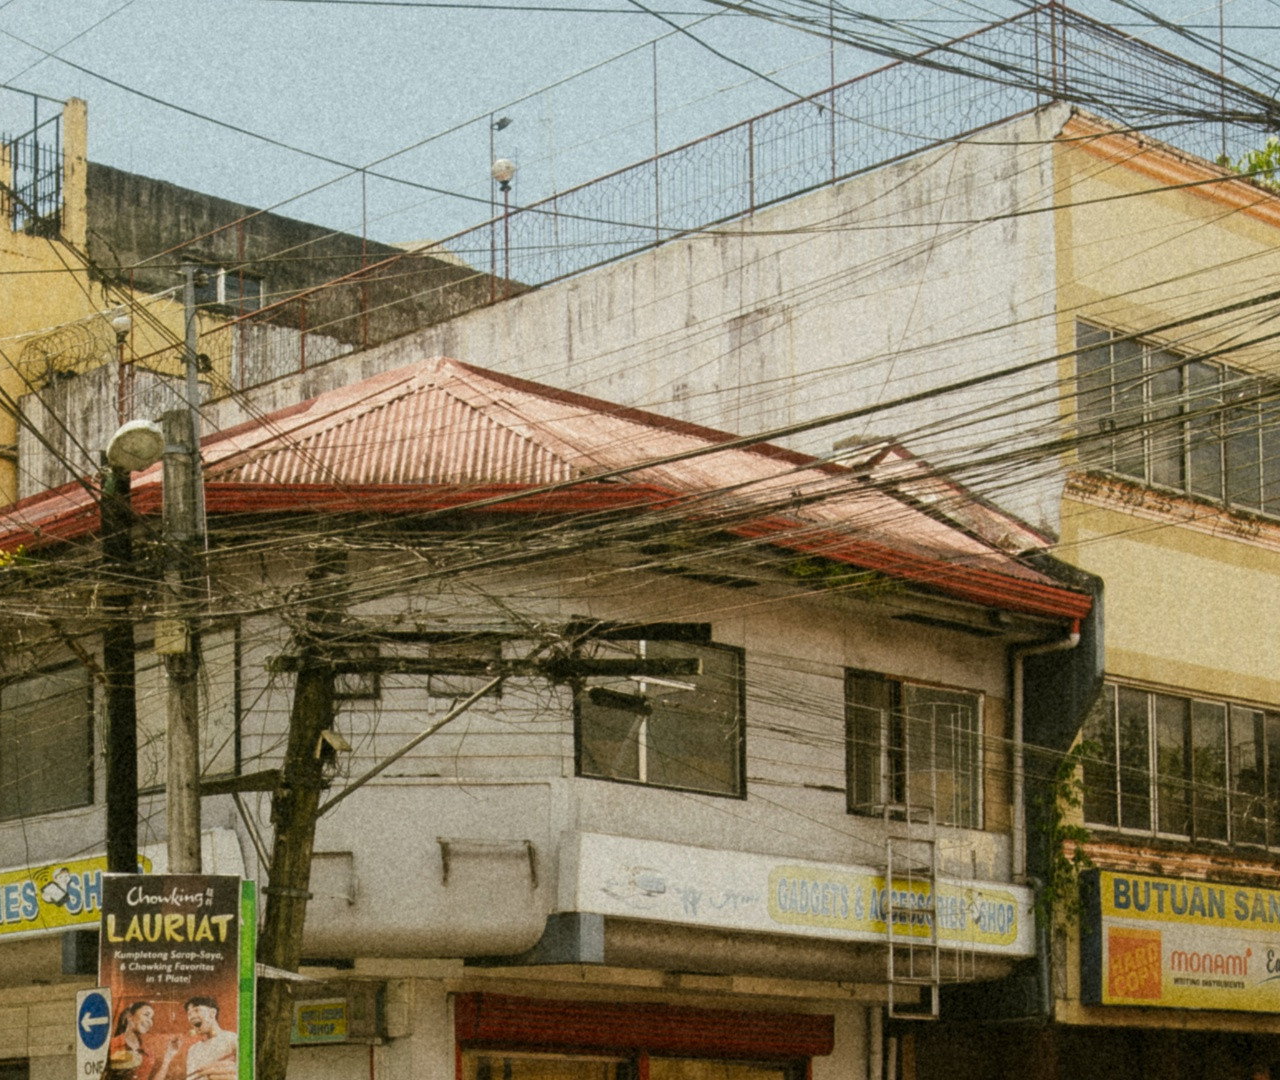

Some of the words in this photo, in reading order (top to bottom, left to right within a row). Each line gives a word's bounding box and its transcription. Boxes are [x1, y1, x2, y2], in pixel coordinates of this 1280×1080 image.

[66, 870, 104, 915] SH
[126, 886, 204, 907] Chowking
[1113, 877, 1226, 919] BUTUAN
[778, 877, 848, 918] GADGETS
[979, 900, 1014, 935] SHOP
[107, 913, 234, 942] LAURIAT
[114, 951, 168, 961] Kumpletong
[128, 963, 172, 972] Chowking
[174, 963, 215, 971] Favorites
[84, 1060, 104, 1075] ONE
